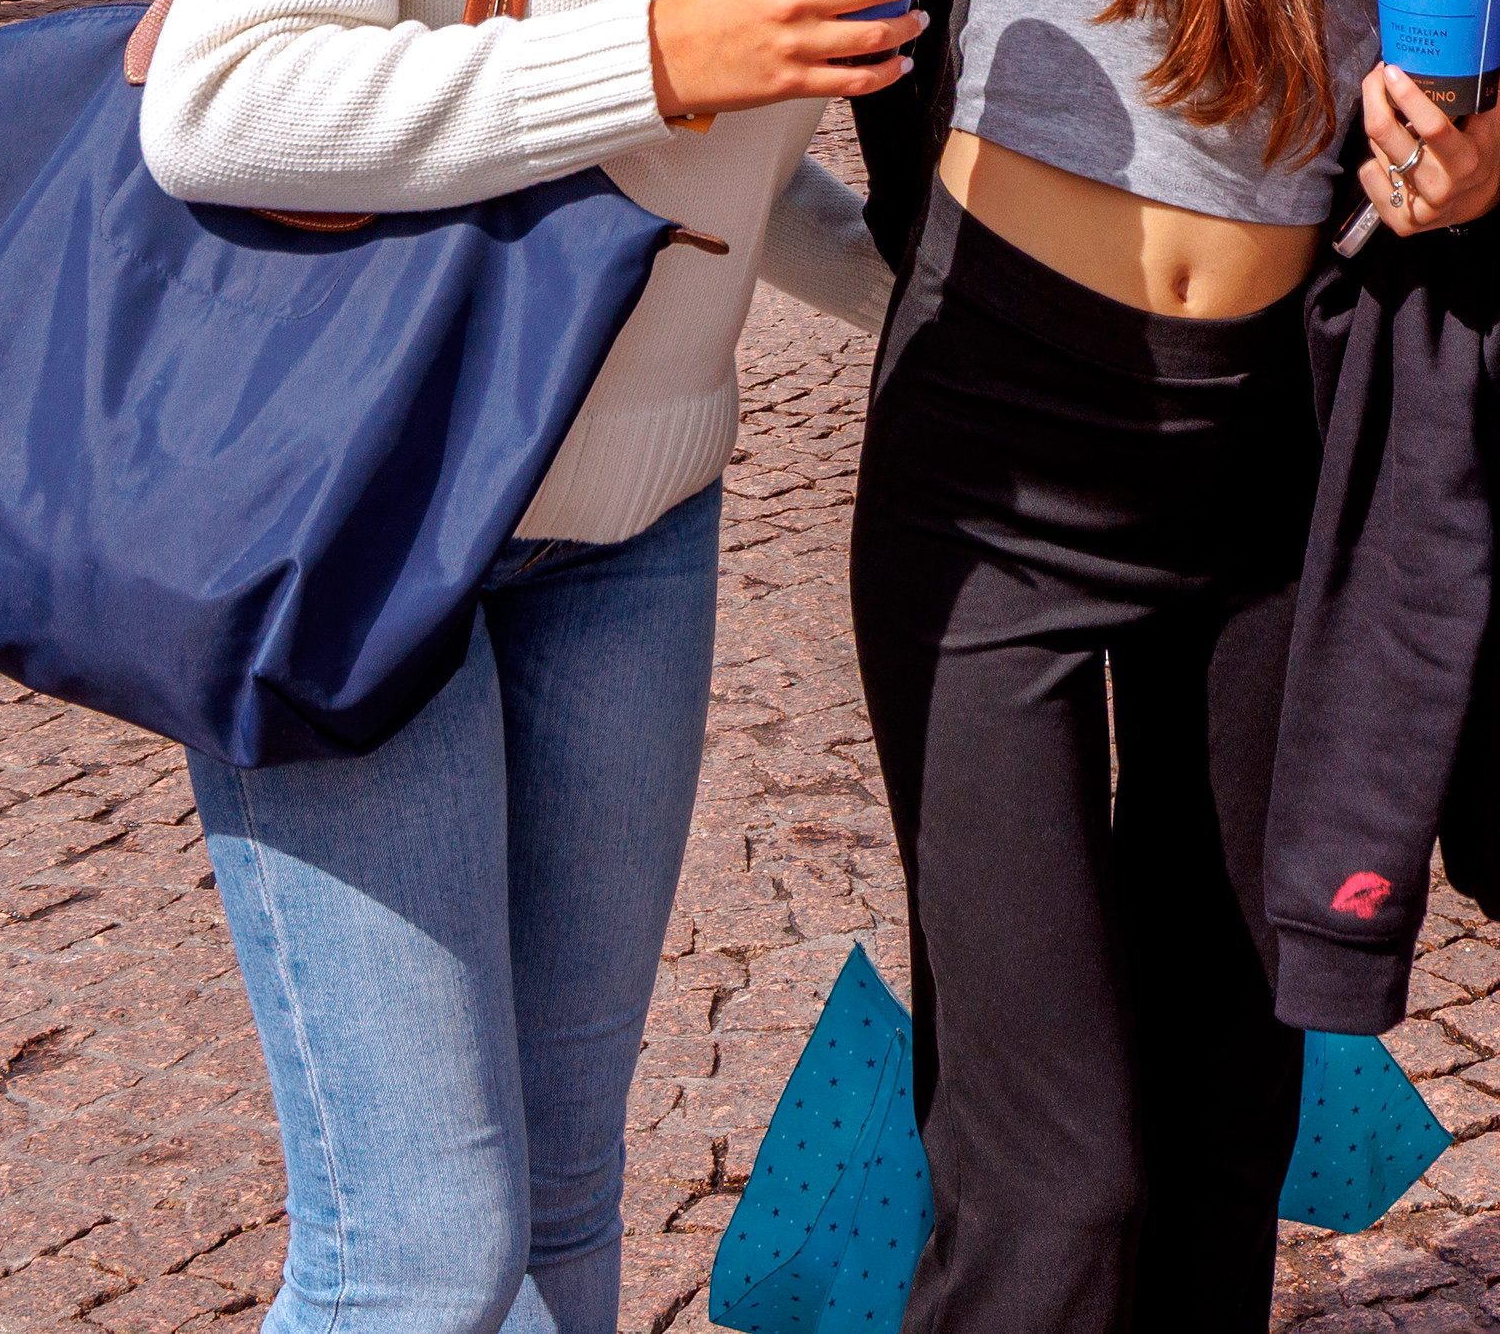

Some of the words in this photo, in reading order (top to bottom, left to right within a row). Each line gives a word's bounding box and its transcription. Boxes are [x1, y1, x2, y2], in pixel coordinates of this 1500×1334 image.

[1391, 22, 1405, 33] THE
[1408, 25, 1448, 37] ITALIAN
[1399, 34, 1435, 46] COFFEE
[1395, 43, 1441, 56] COMPANY
